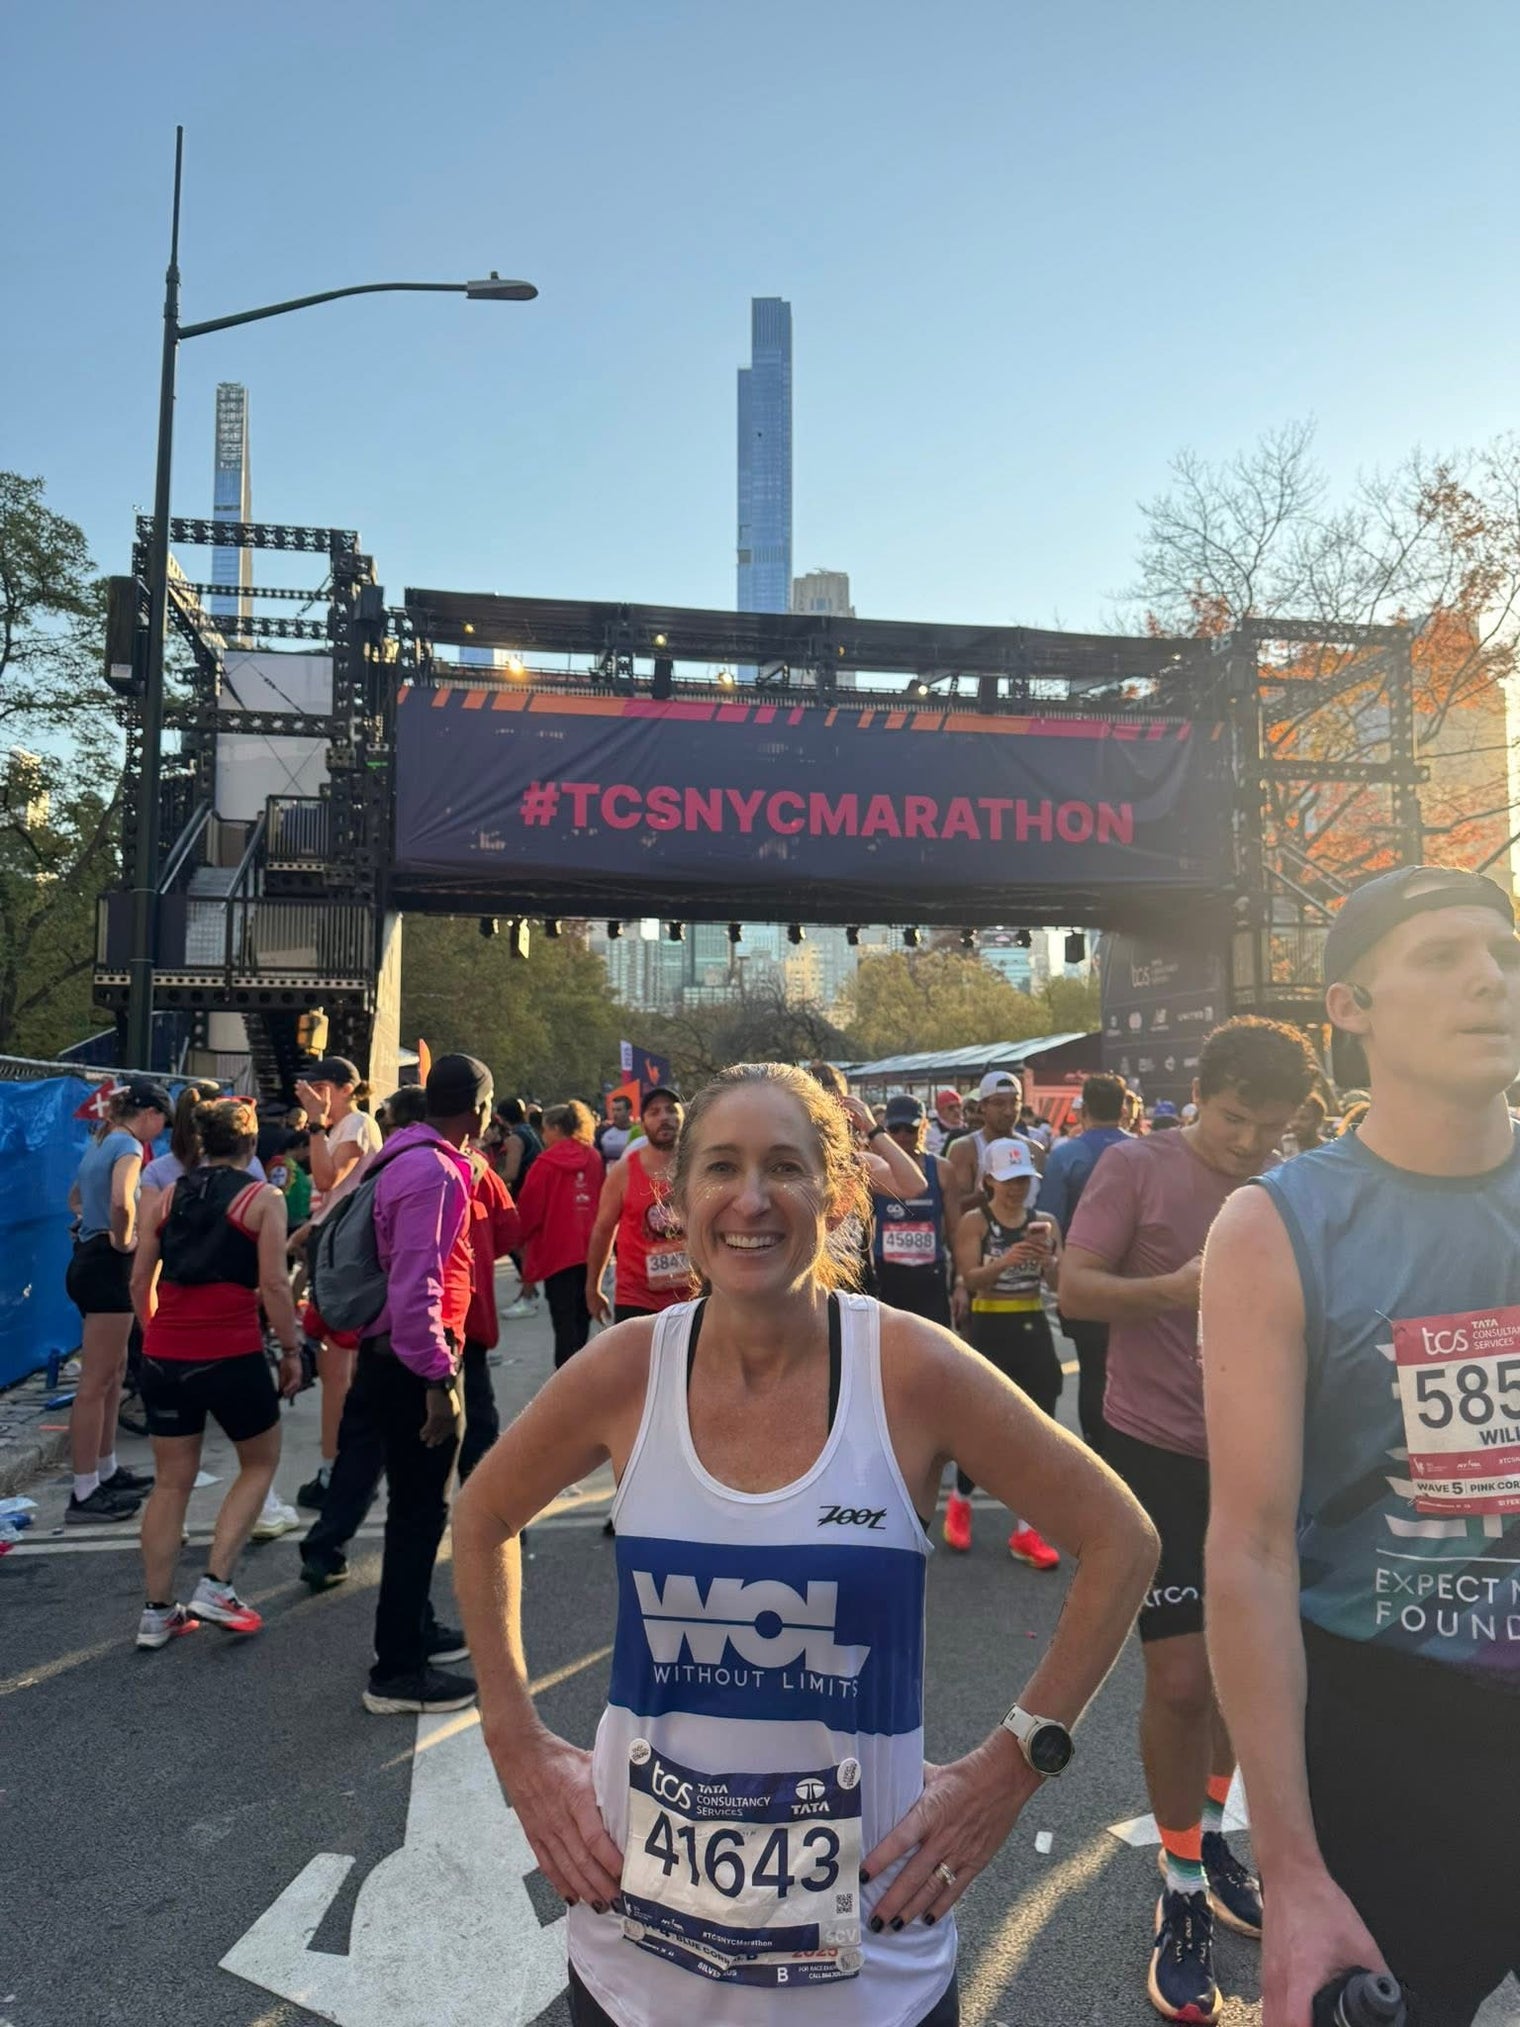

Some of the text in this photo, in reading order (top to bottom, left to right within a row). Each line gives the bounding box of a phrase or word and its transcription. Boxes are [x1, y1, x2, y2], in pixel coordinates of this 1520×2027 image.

[519, 780, 1134, 844] #TCSNYCMARATHON
[1471, 1318, 1499, 1329] TATA
[1421, 1327, 1469, 1356] tcs
[1473, 1337, 1514, 1350] SERVICES
[1417, 1481, 1520, 1495] WAVE 5 PINK COR
[1376, 1567, 1500, 1604] EXPECT
[631, 1570, 872, 1678] WOL
[653, 1664, 859, 1699] WITHOUT LIMITS
[651, 1760, 694, 1810] tcs
[697, 1783, 729, 1794] TATA
[696, 1795, 771, 1808] CONSULTANCY
[791, 1802, 830, 1815] TATA
[696, 1805, 744, 1817] SERVICES
[644, 1810, 841, 1900] 41643
[777, 1966, 789, 1983] B
